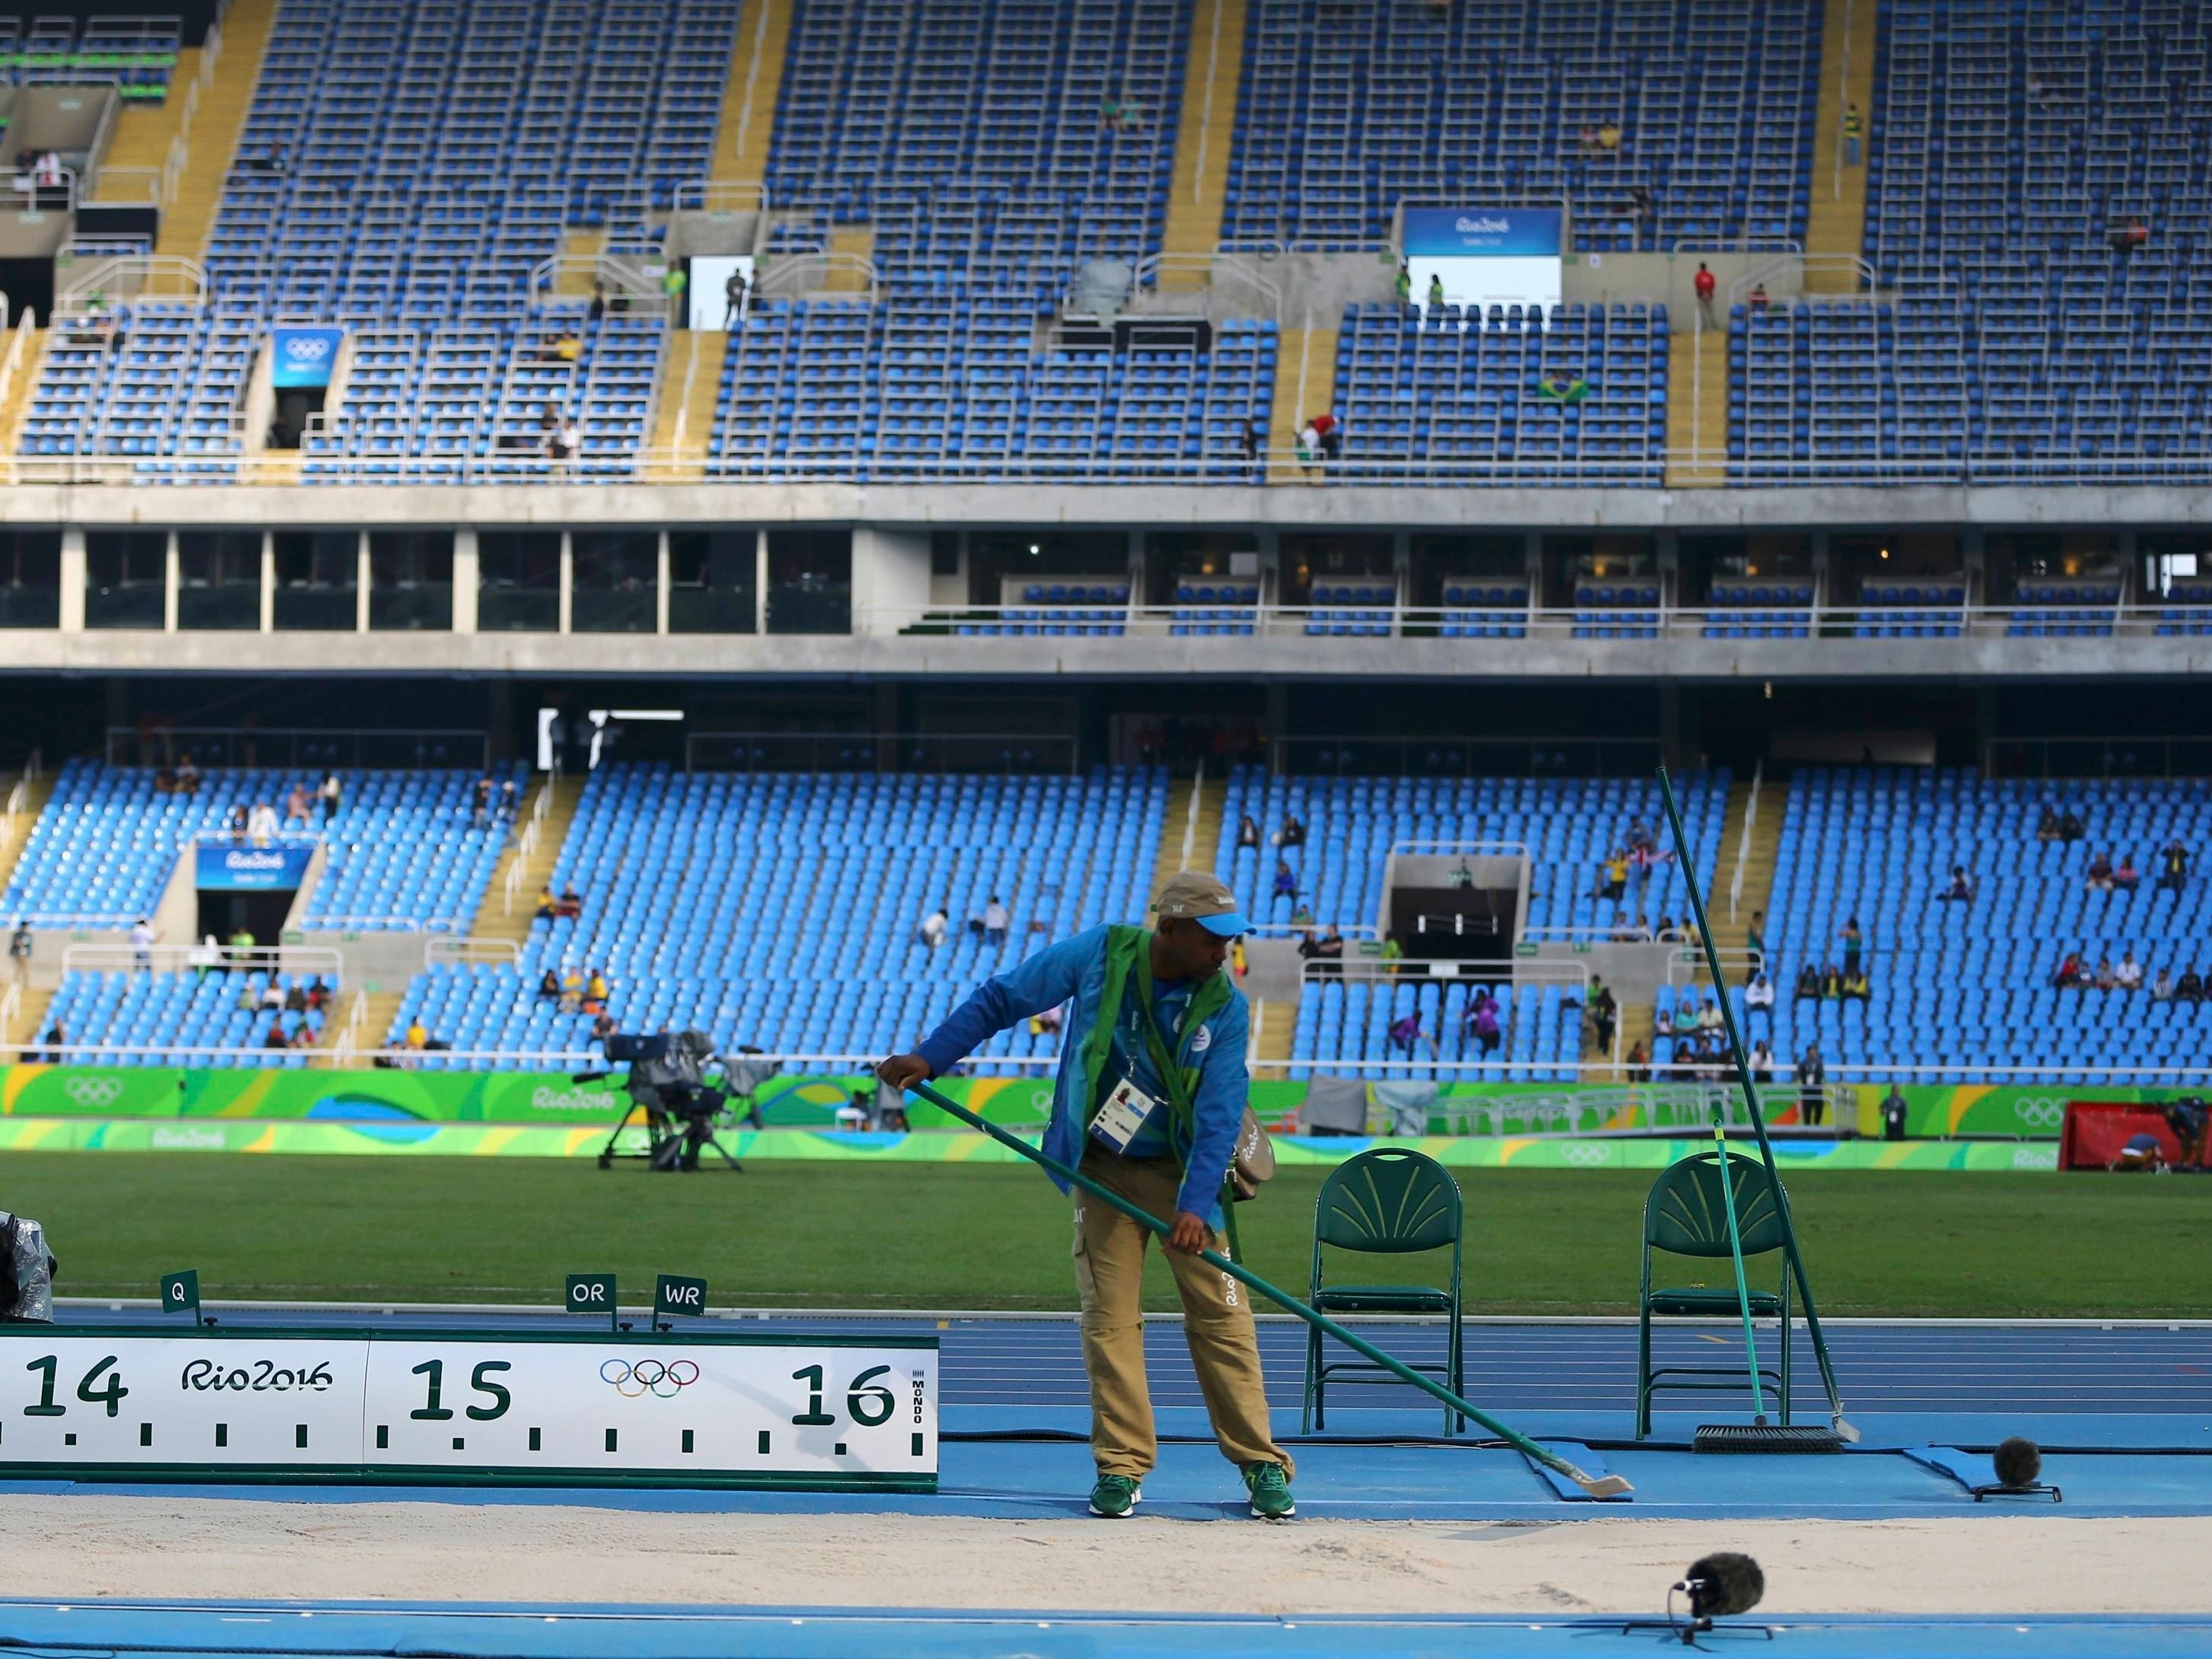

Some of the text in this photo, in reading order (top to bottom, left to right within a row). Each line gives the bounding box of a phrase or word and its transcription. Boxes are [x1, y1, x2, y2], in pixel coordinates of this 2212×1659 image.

[532, 1086, 617, 1109] Rio2016
[172, 1282, 185, 1302] Q
[572, 1283, 605, 1302] OR
[665, 1284, 699, 1305] WR
[23, 1355, 129, 1417] 14
[181, 1359, 334, 1391] Rio2016
[410, 1359, 512, 1420] 15
[792, 1364, 895, 1427] 16
[912, 1381, 924, 1424] MONDO
